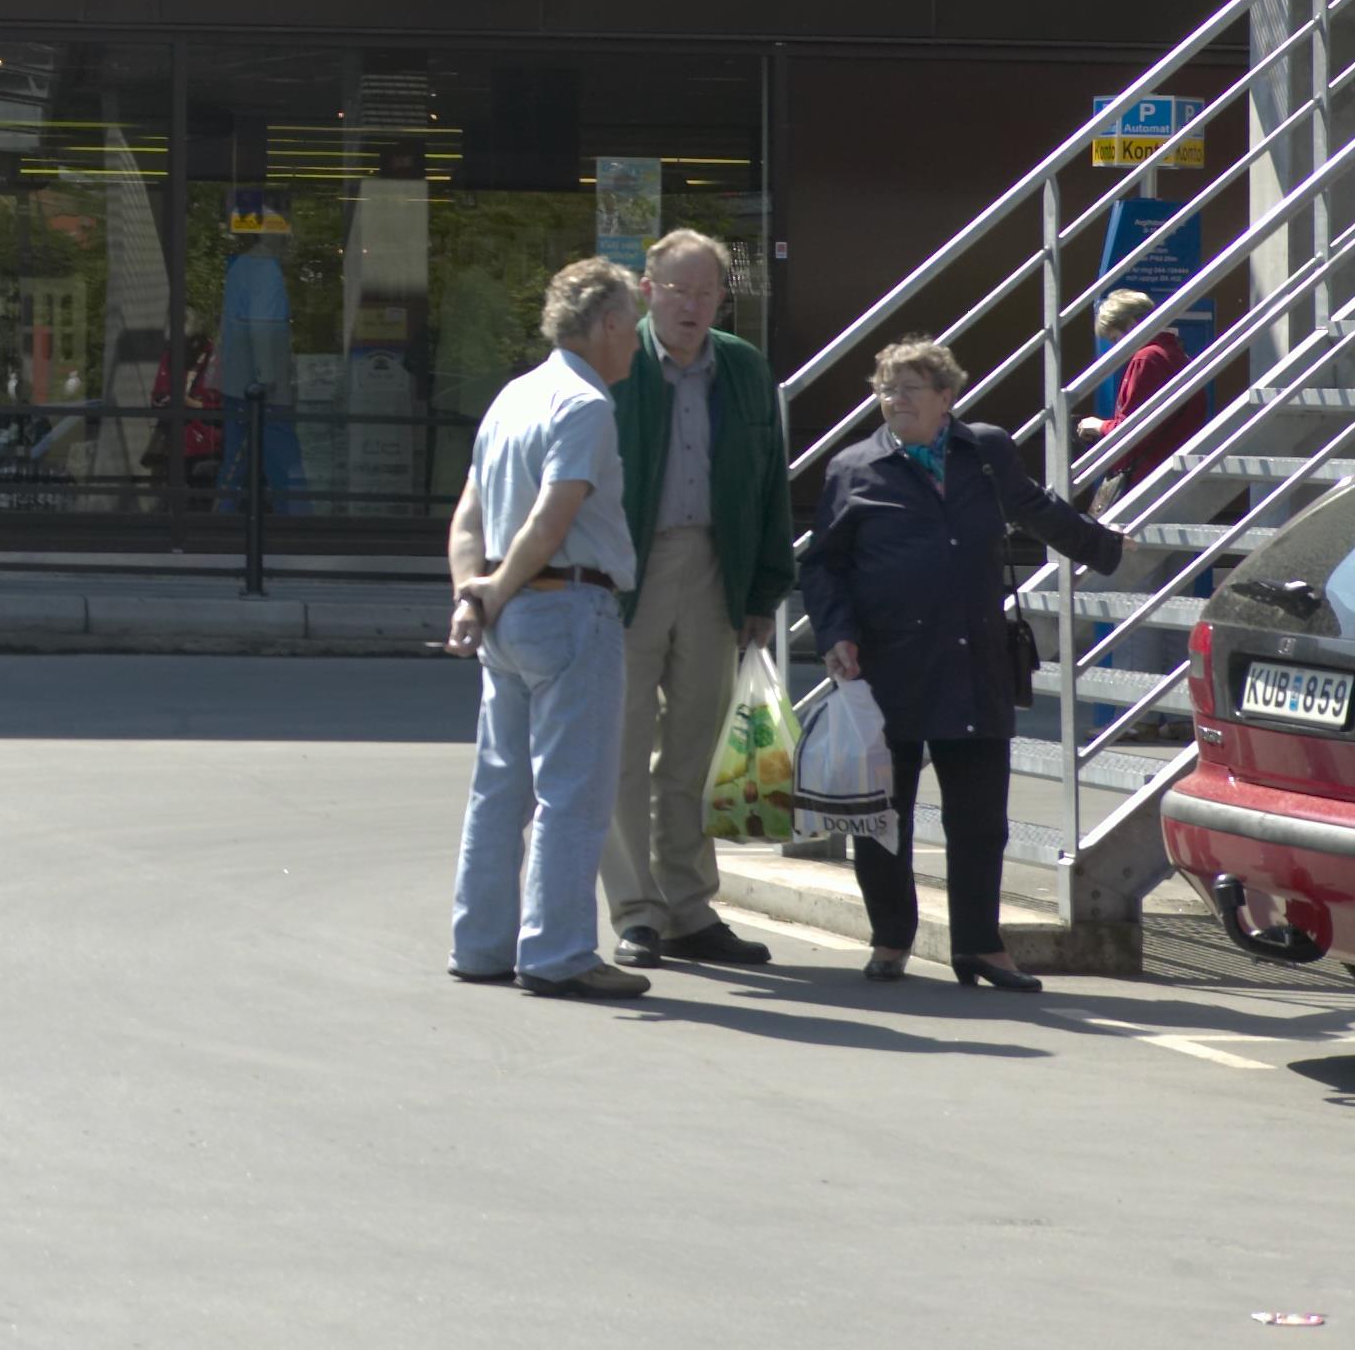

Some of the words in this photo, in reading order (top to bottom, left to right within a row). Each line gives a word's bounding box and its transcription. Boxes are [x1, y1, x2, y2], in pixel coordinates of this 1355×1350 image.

[1139, 102, 1156, 123] P
[1123, 123, 1171, 133] Automat
[1246, 667, 1290, 708] KUB
[1303, 675, 1347, 718] 859
[822, 814, 889, 834] DOMUS
